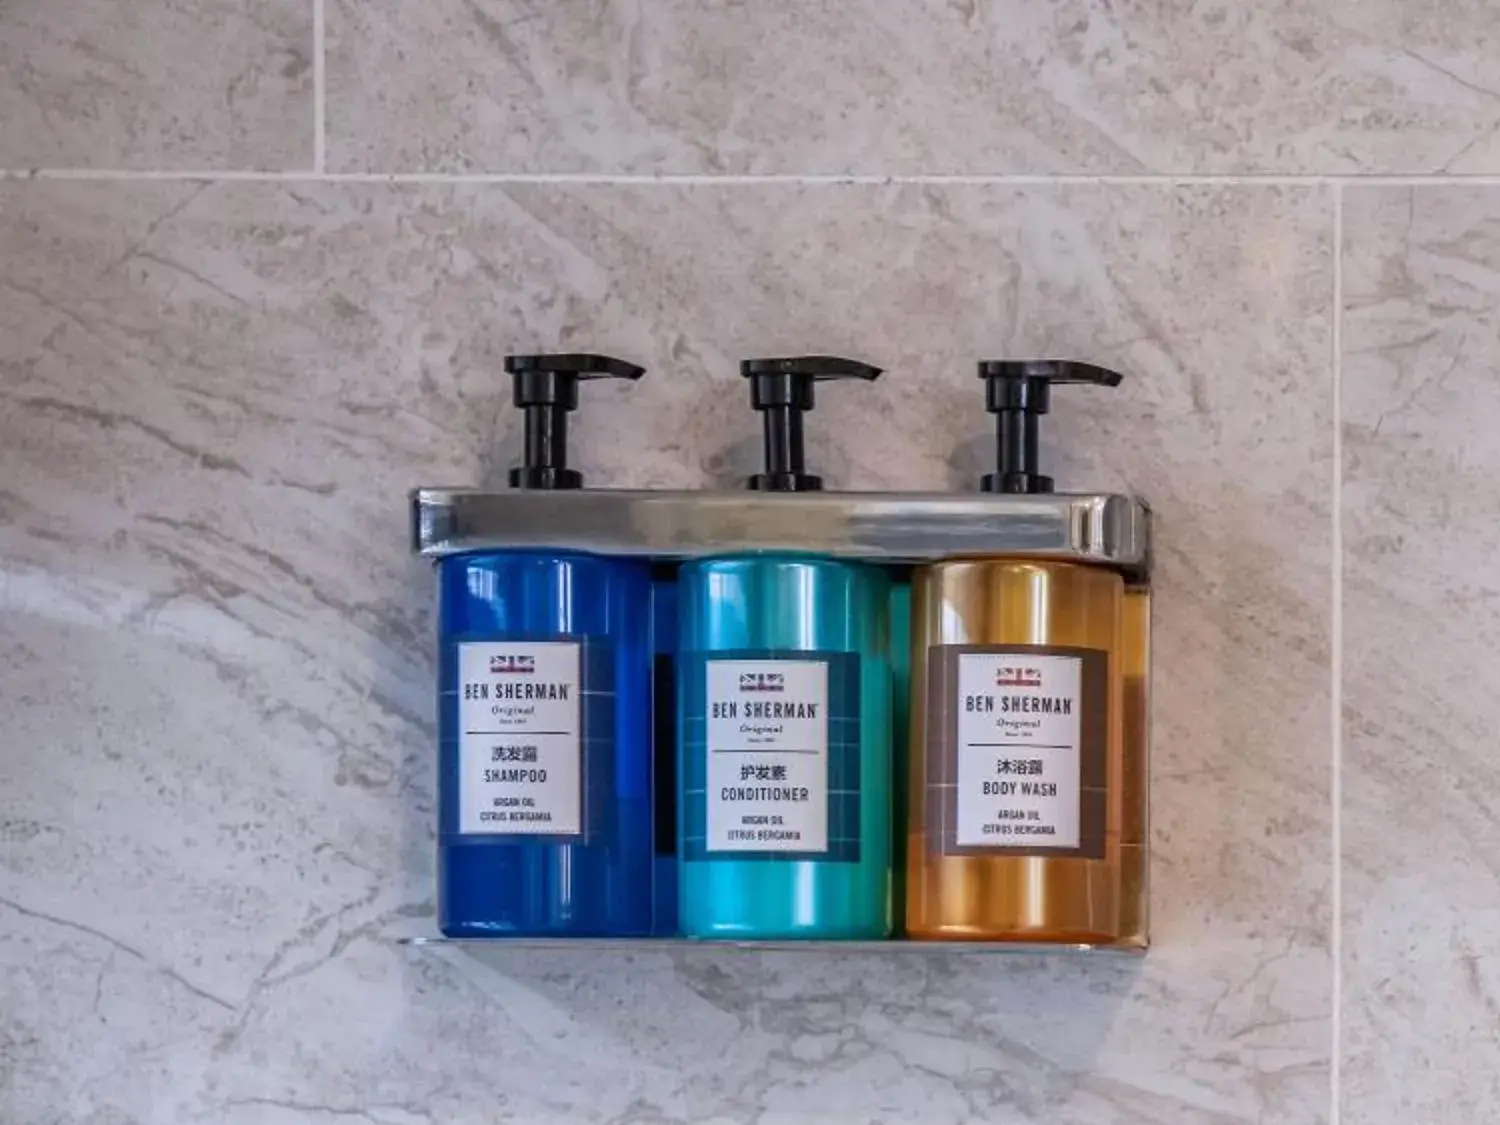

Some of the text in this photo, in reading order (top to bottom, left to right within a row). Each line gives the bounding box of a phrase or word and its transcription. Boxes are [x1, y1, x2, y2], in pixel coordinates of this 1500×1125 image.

[465, 683, 569, 700] BEN SHERMAN
[712, 701, 816, 719] BEN SHERMAN
[966, 695, 1072, 715] BEN SHERMAN
[484, 769, 547, 783] SHAMPOO
[721, 787, 809, 801] CONDITIONER
[982, 781, 1057, 797] BODY WASH
